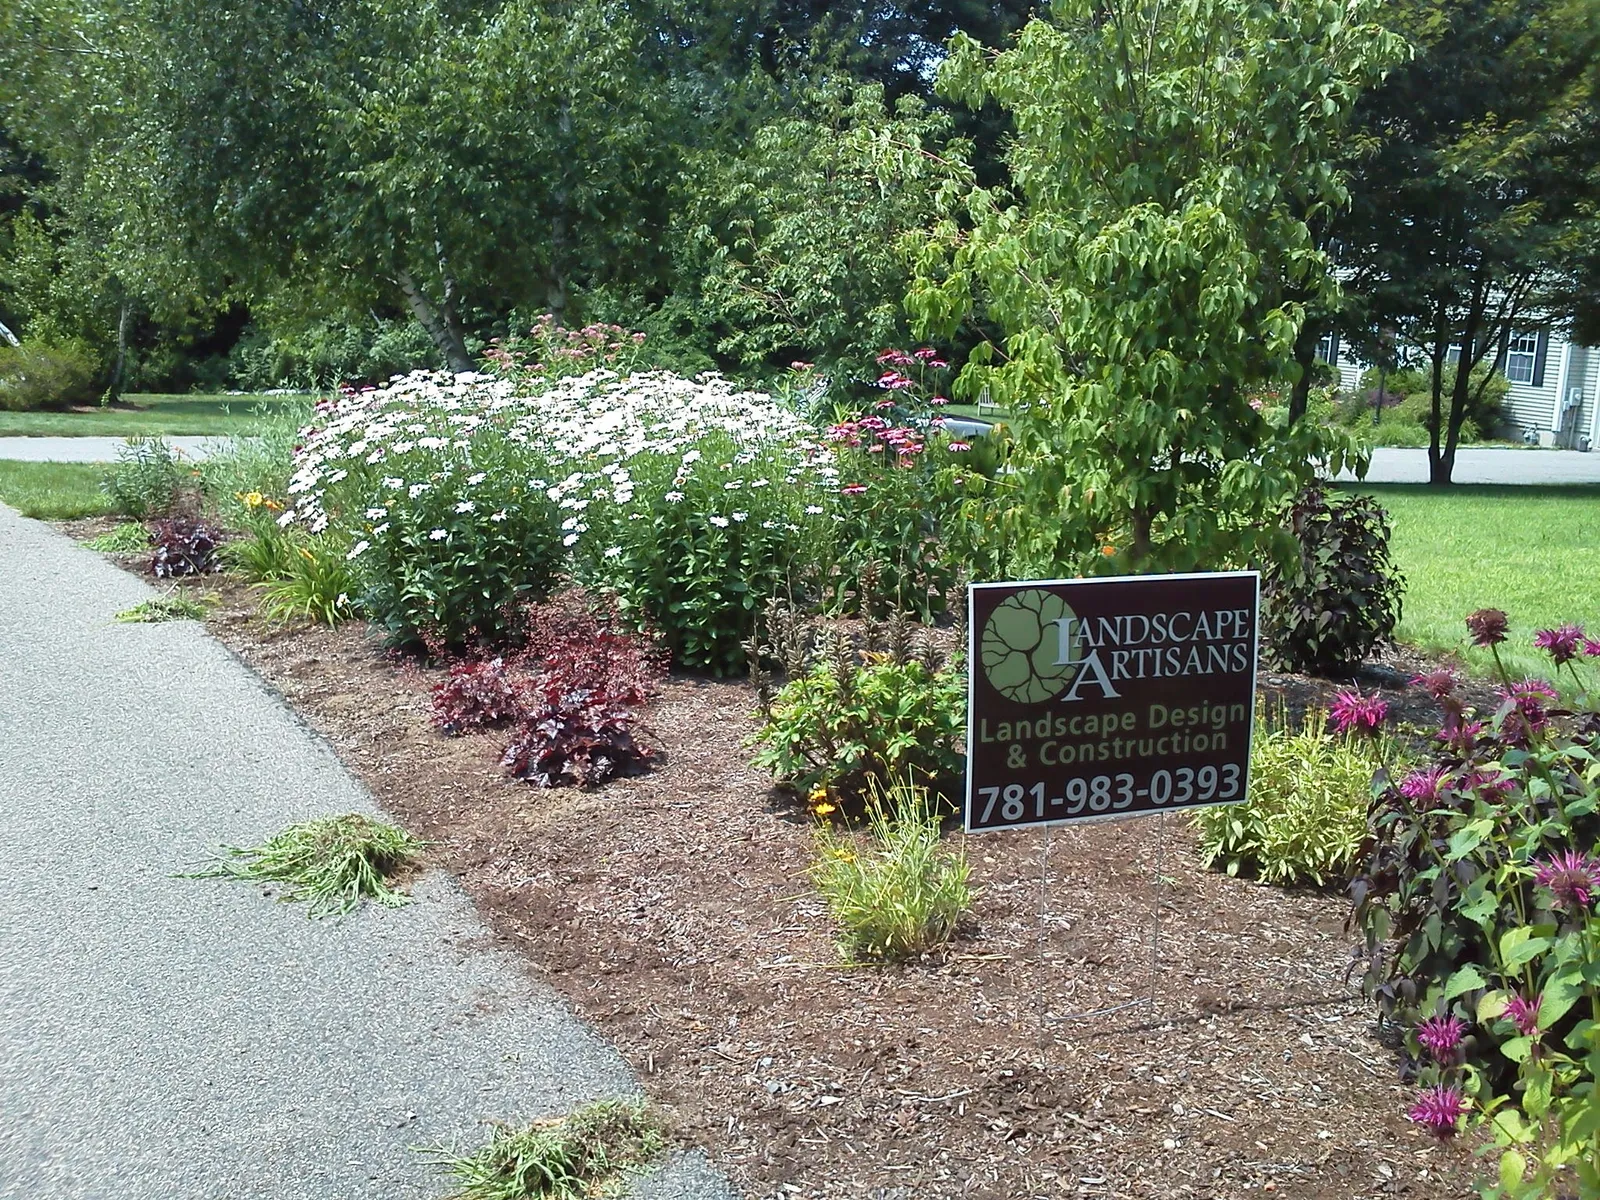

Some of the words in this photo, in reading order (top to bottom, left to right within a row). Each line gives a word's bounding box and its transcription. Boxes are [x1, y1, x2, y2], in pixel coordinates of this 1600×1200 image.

[1052, 608, 1249, 666] LANDSCAPE
[1061, 643, 1248, 702] ARTISANS
[981, 711, 1136, 743] Landscape
[1150, 700, 1245, 730] Design
[1007, 744, 1027, 769] &
[1040, 729, 1227, 766] Construction
[978, 763, 1241, 824] 781-983-0393
